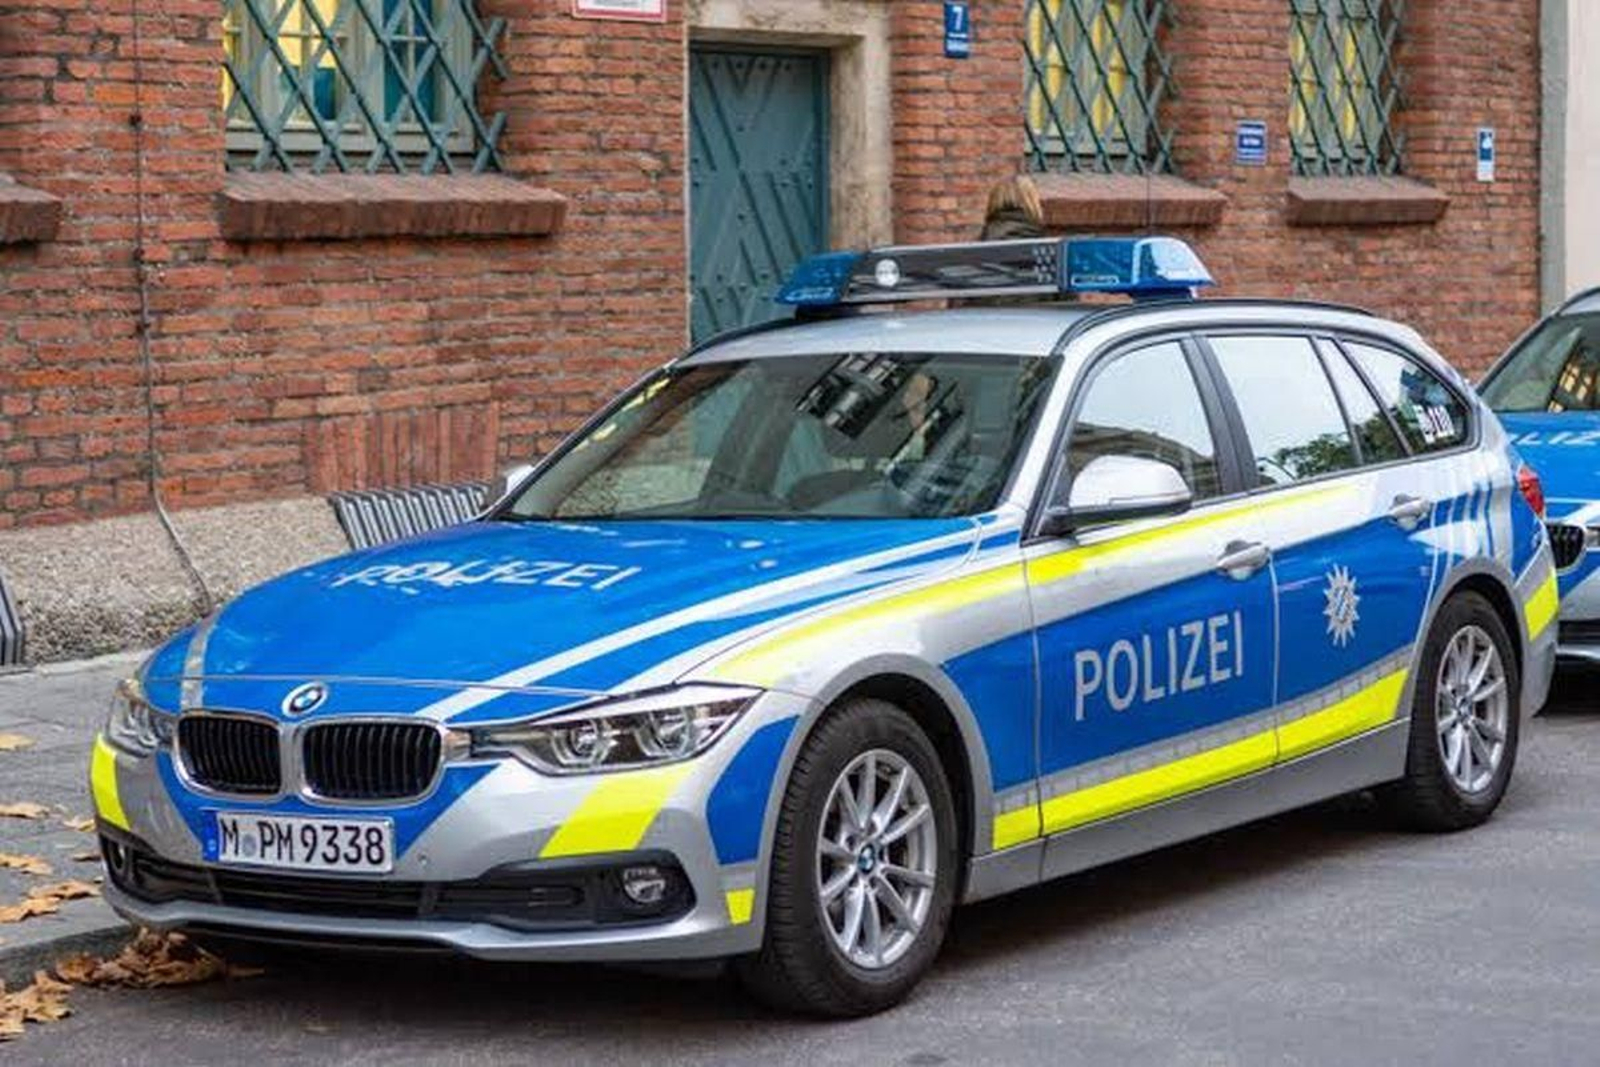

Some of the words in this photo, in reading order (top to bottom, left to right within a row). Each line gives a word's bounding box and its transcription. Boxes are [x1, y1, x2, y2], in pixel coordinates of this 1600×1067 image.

[952, 6, 963, 30] 7
[1074, 609, 1243, 721] POLIZEI
[220, 819, 239, 856] M
[300, 824, 385, 865] 9338
